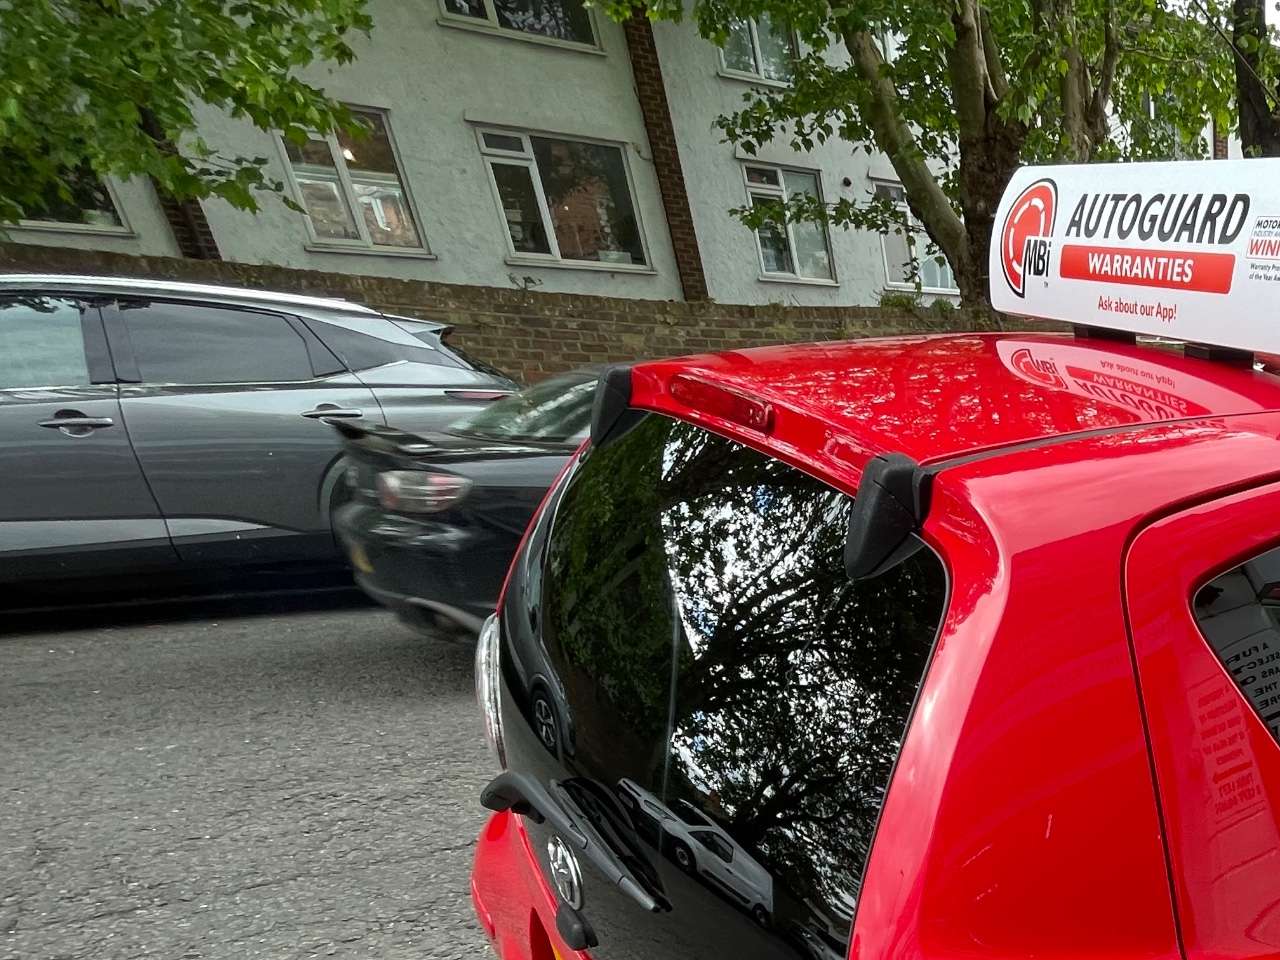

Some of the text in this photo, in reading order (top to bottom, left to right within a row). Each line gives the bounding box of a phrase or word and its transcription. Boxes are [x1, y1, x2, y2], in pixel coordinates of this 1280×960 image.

[1065, 193, 1251, 245] AUTOGUARD
[1088, 252, 1194, 283] WARRANTIES
[1098, 296, 1177, 322] Ask about our App!
